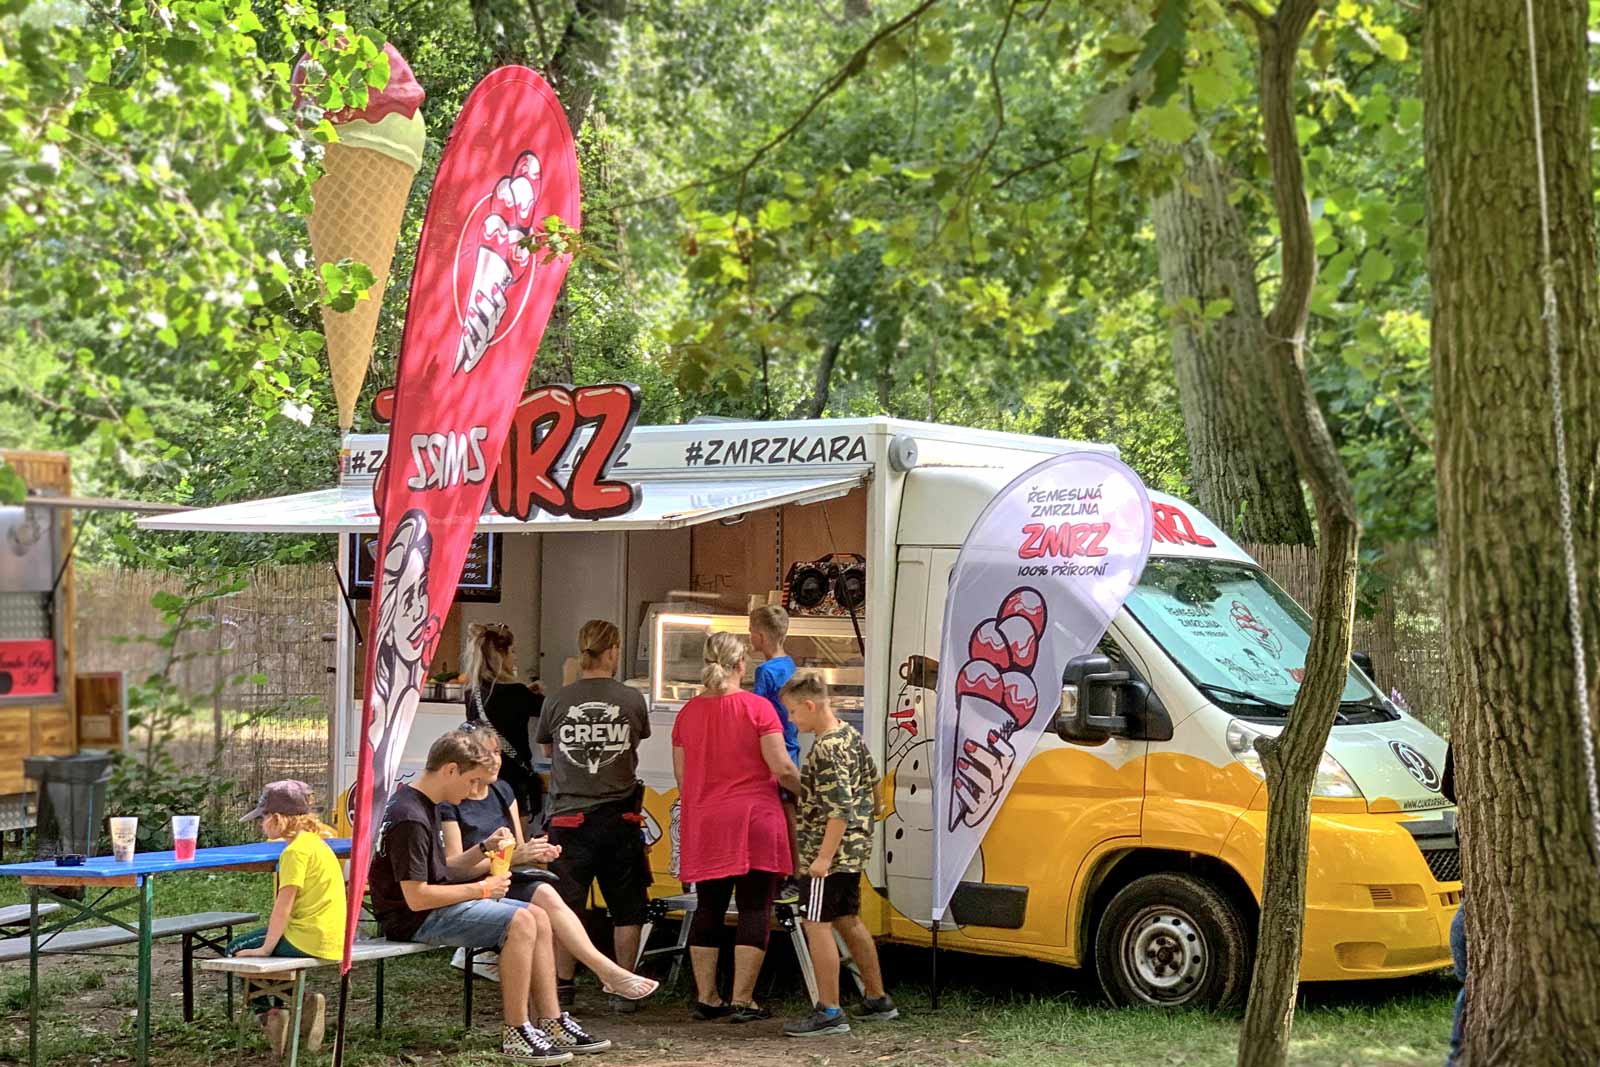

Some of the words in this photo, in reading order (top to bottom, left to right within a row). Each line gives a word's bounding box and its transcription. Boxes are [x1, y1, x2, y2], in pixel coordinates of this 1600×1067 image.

[685, 436, 868, 467] #ZMRZKARA
[1027, 484, 1104, 503] ŘEMESLNÁ
[1031, 503, 1100, 518] ZMRZLINA
[1018, 521, 1111, 560] ZMRZ
[1017, 564, 1049, 577] 100%
[1050, 561, 1110, 577] PŘÍRODNÍ
[560, 723, 630, 743] CREW
